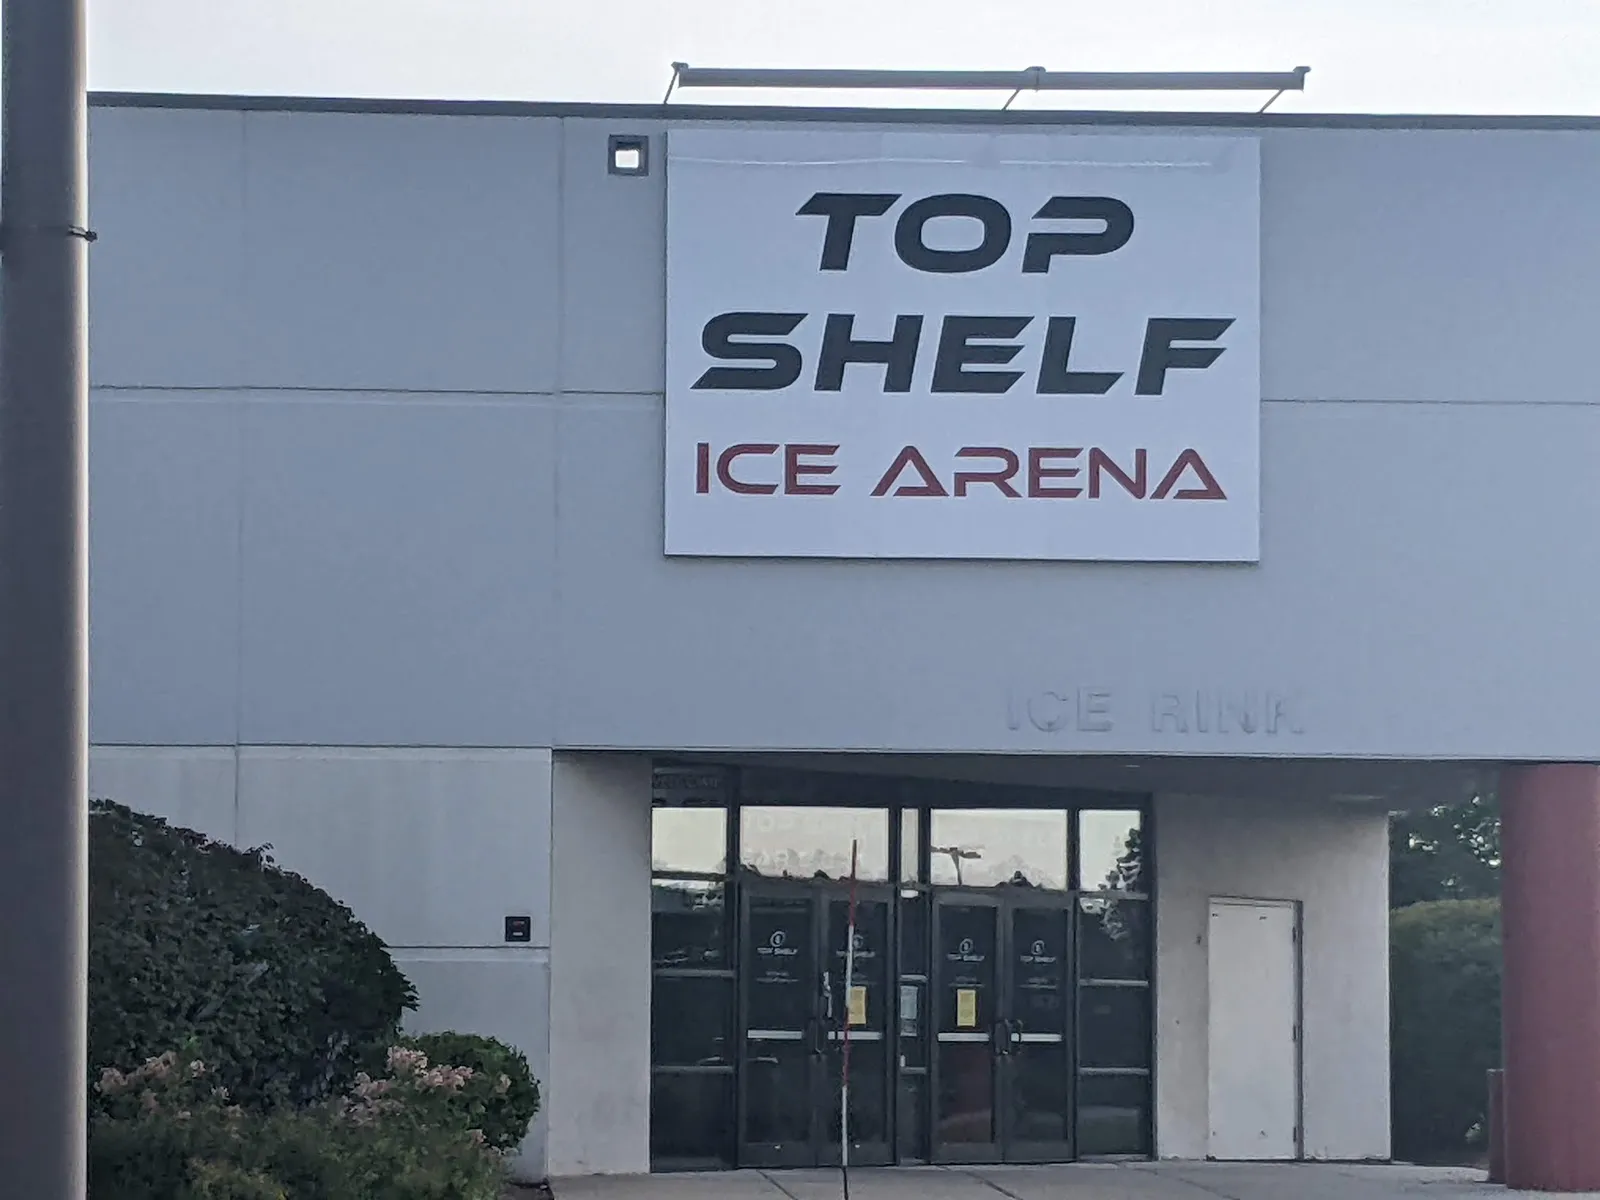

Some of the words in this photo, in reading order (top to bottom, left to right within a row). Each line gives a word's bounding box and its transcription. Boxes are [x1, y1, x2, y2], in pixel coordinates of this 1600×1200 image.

[795, 192, 1135, 274] TOP
[690, 311, 1237, 396] SHELF
[695, 442, 841, 496] ICE
[869, 444, 1228, 501] ARENA
[1006, 685, 1115, 733] ICE
[1150, 687, 1307, 735] RINK
